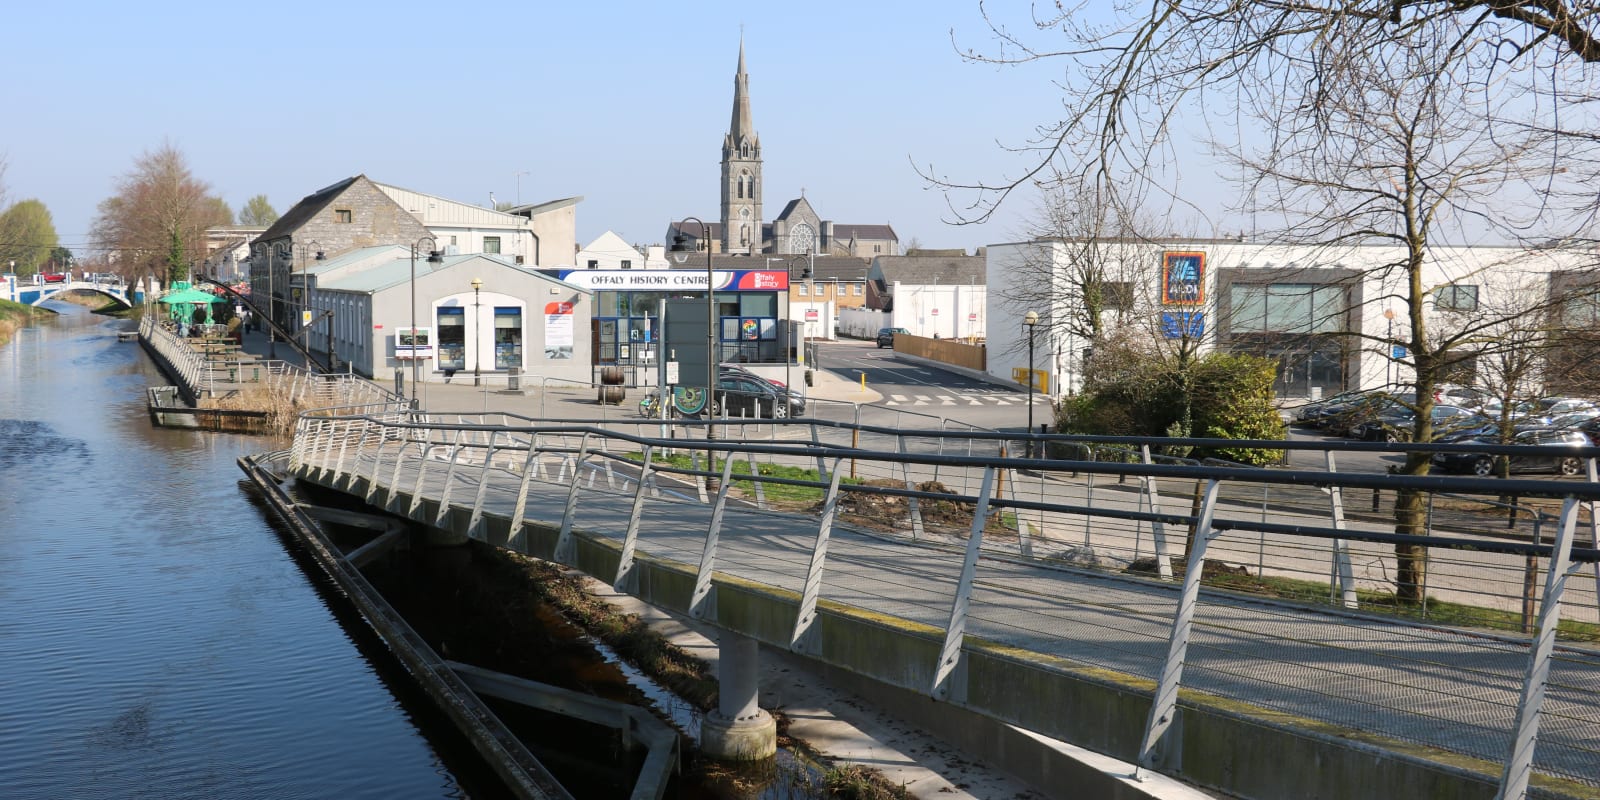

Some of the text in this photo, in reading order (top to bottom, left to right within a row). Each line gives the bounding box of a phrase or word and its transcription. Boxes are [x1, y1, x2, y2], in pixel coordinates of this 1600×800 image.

[591, 275, 709, 284] OFFALY HISTORY CENTRE
